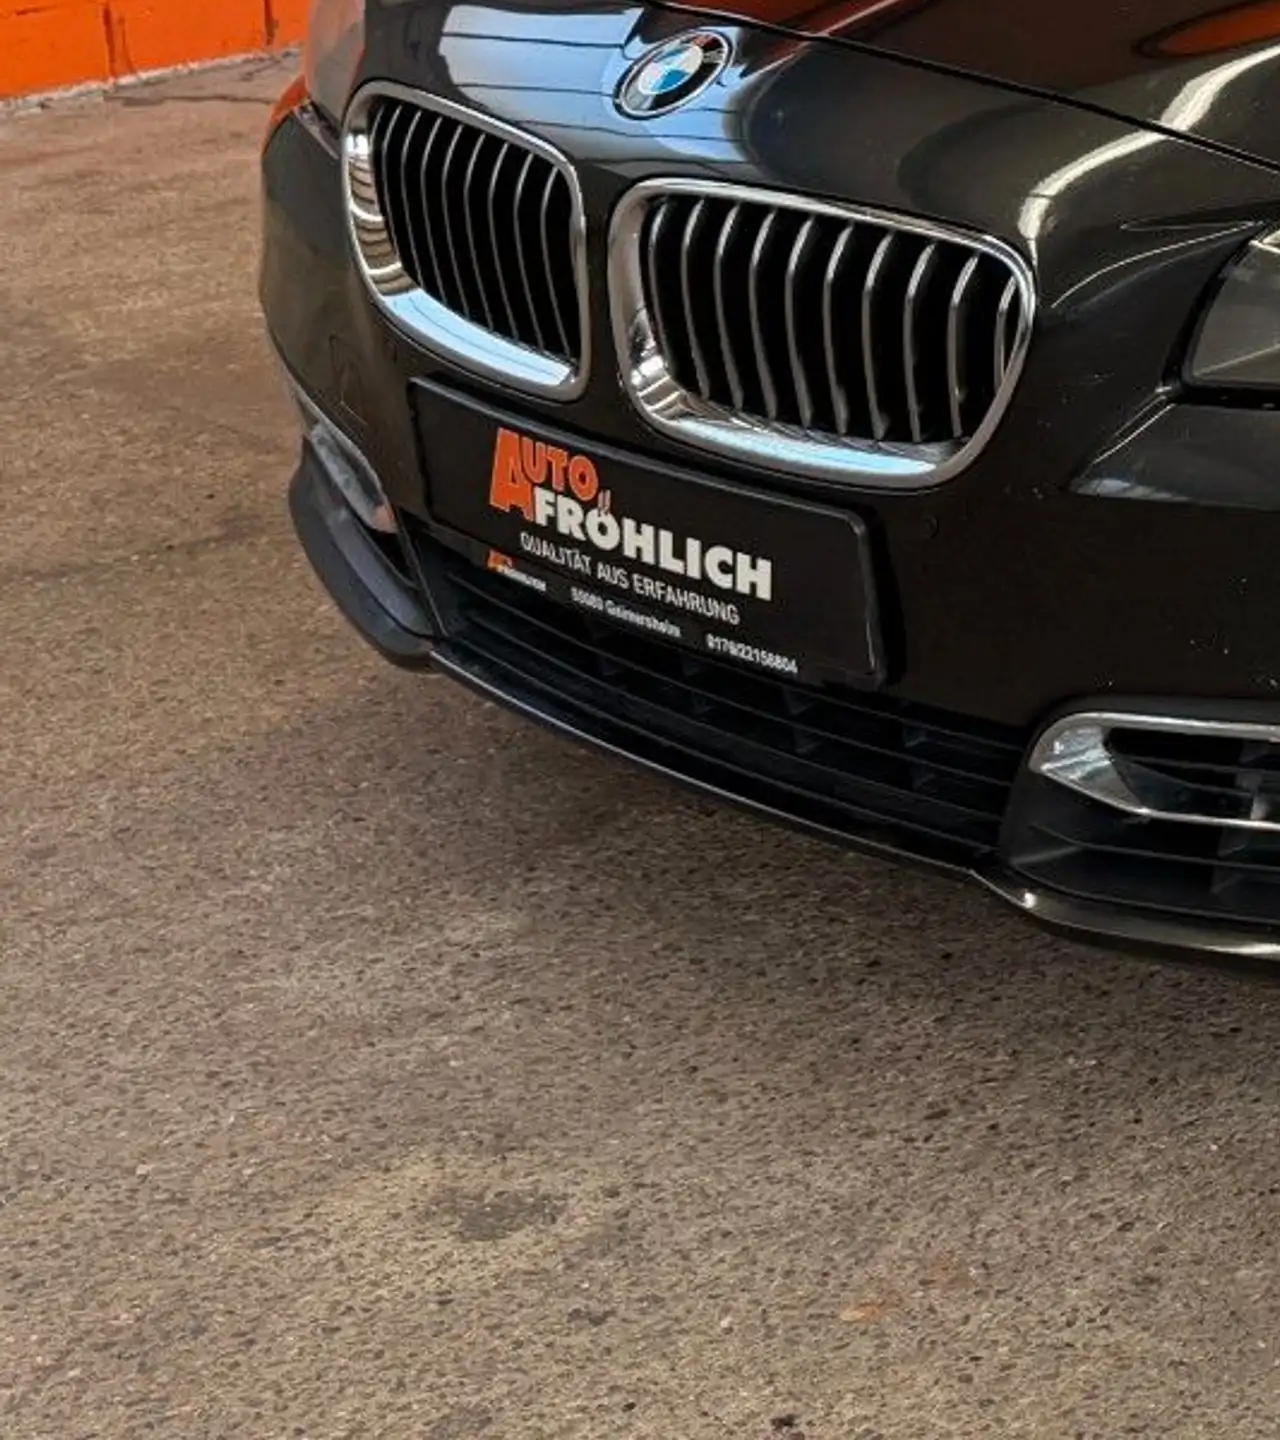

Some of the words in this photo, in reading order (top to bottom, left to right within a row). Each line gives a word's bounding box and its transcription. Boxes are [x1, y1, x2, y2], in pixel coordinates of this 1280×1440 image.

[490, 427, 599, 522] AUTO
[519, 531, 593, 577] QUALITÄT
[597, 561, 630, 589] AUS
[633, 573, 741, 626] ERFAHRUNG
[532, 490, 772, 601] FRÖHLICH
